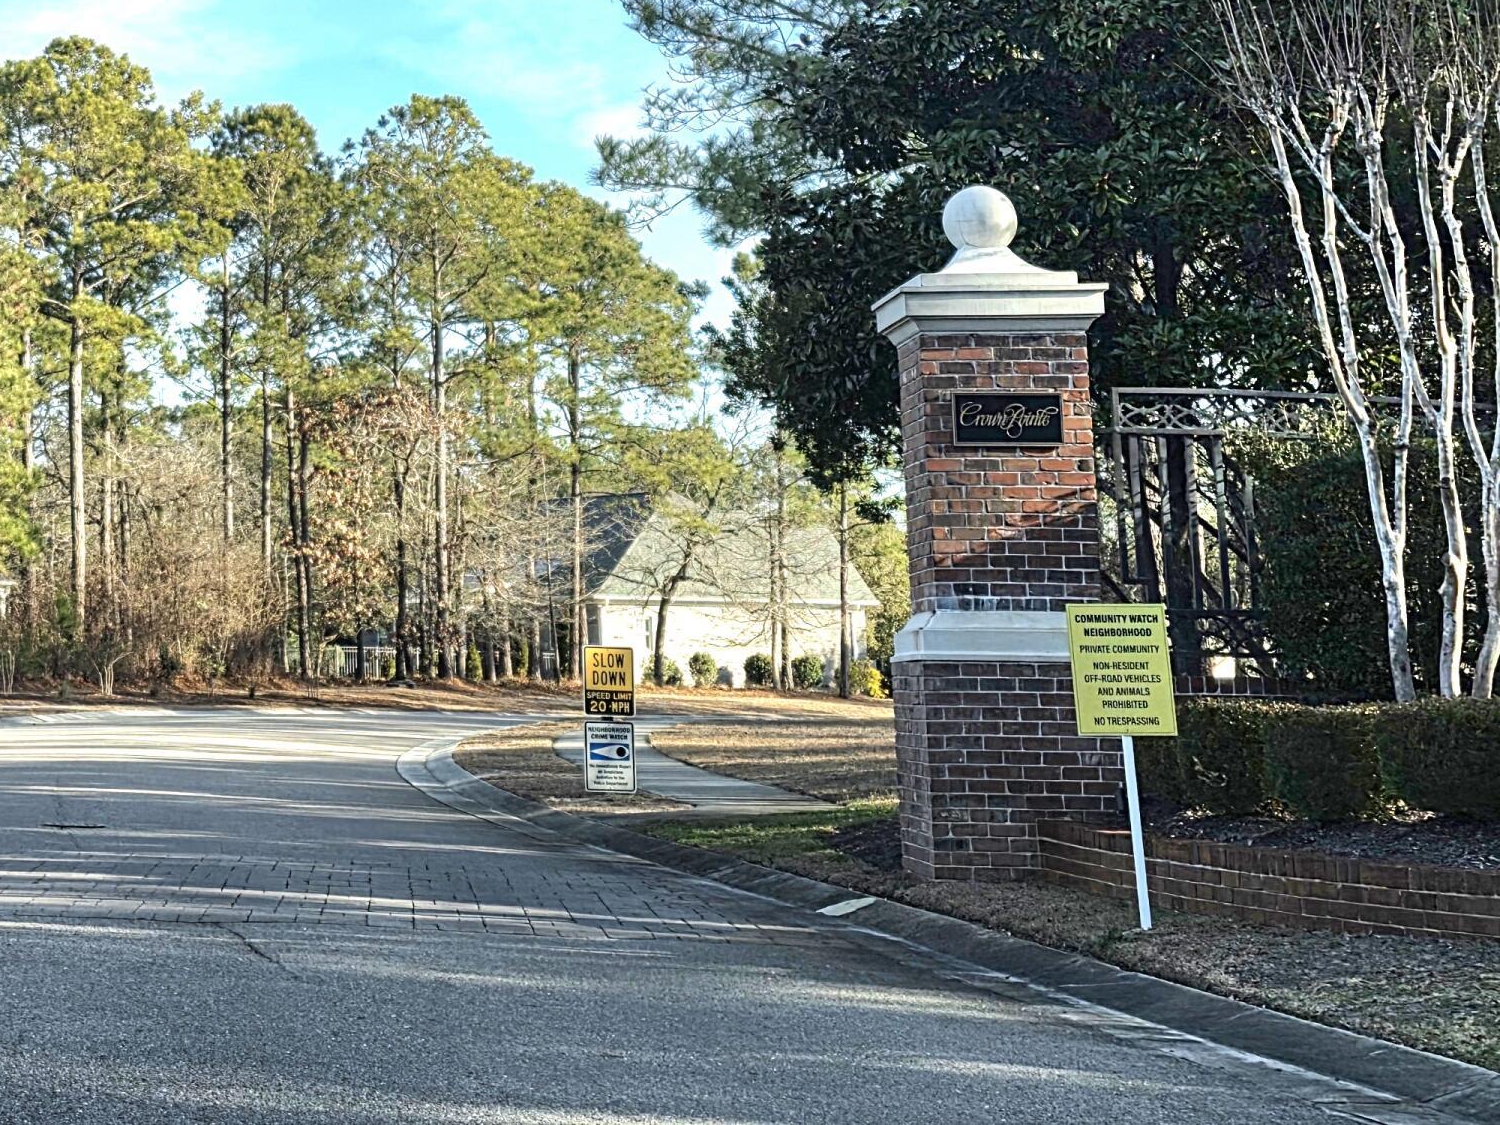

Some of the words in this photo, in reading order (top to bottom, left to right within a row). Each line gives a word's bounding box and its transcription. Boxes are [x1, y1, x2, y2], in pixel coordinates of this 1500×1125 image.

[960, 401, 1005, 426] Crown
[1000, 403, 1059, 438] Pointe
[1075, 614, 1127, 624] COMMUNITY
[1129, 614, 1159, 624] WATCH
[1084, 628, 1152, 637] NEIGHBORHOOD
[1080, 645, 1111, 654] PRIVATE
[1112, 645, 1160, 654] COMMUNITY
[593, 653, 624, 668] SLOW
[1093, 661, 1149, 670] NON-RESIDENT
[592, 671, 626, 686] DOWN
[1084, 674, 1122, 683] OFF-ROAD
[1124, 674, 1161, 683] VEHICLES
[586, 692, 611, 700] SPEED
[613, 692, 632, 700] LIMIT
[1098, 687, 1114, 696] AND
[1115, 687, 1150, 696] ANIMALS
[590, 701, 607, 712] 20
[1102, 700, 1148, 709] PROHIBITED
[1094, 717, 1106, 725] NO
[1107, 716, 1160, 726] TRESPASSING
